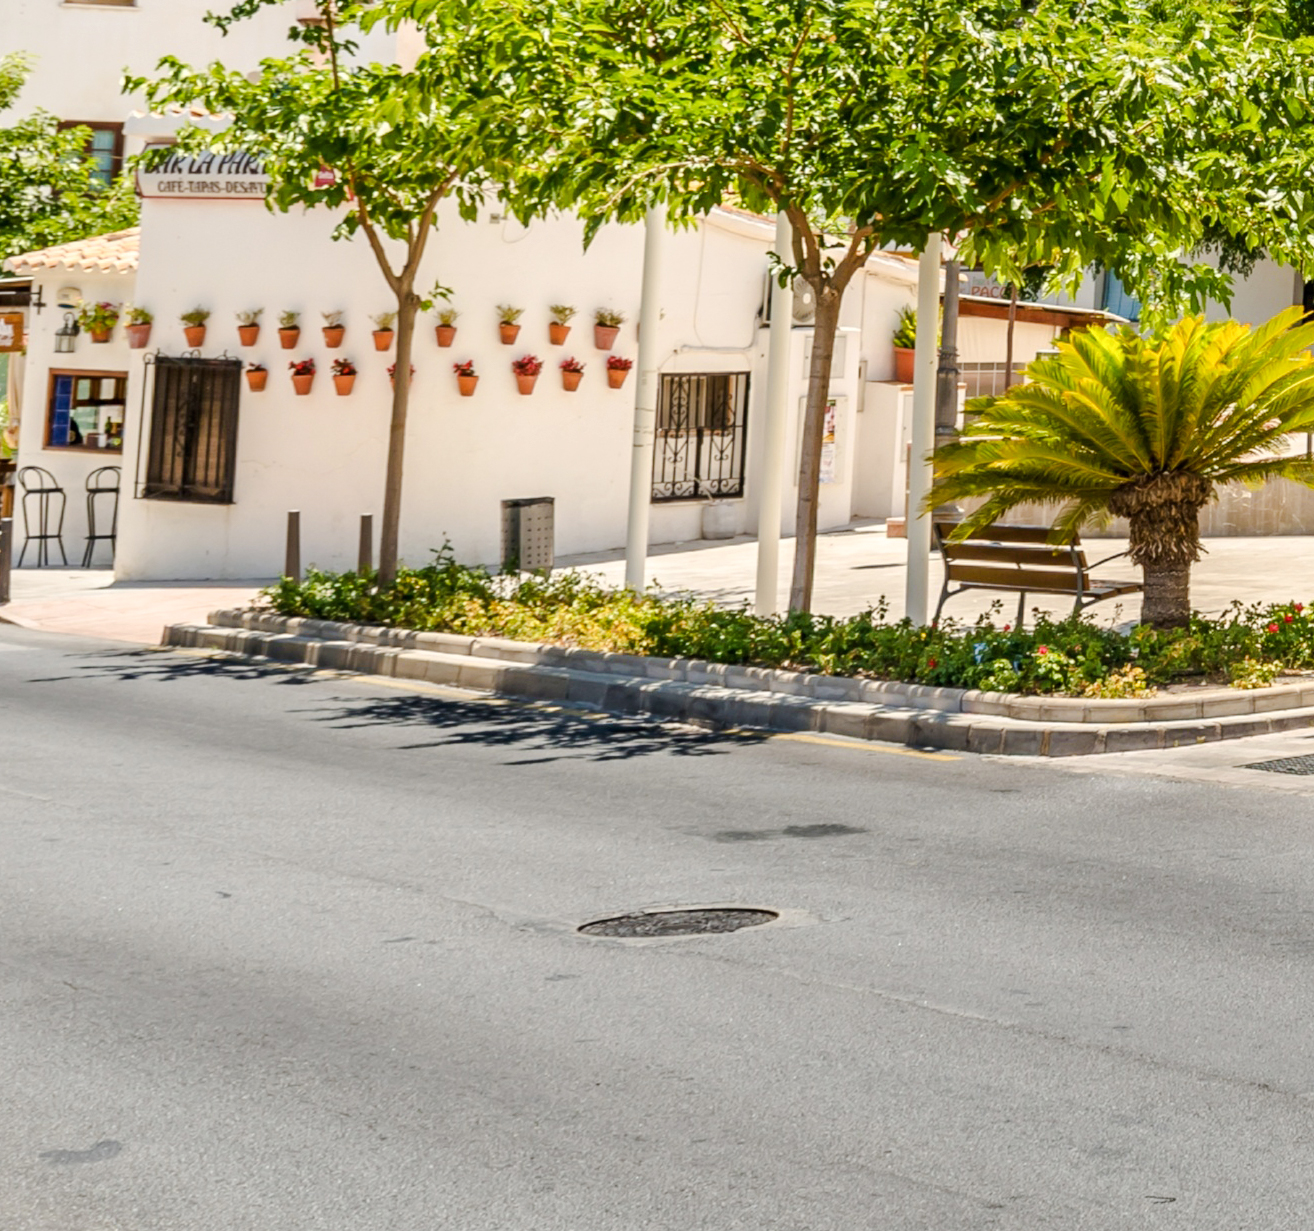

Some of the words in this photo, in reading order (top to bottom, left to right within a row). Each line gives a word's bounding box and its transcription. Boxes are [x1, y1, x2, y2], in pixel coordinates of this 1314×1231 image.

[144, 150, 187, 174] AR
[188, 152, 215, 174] LA
[217, 150, 268, 174] PAR
